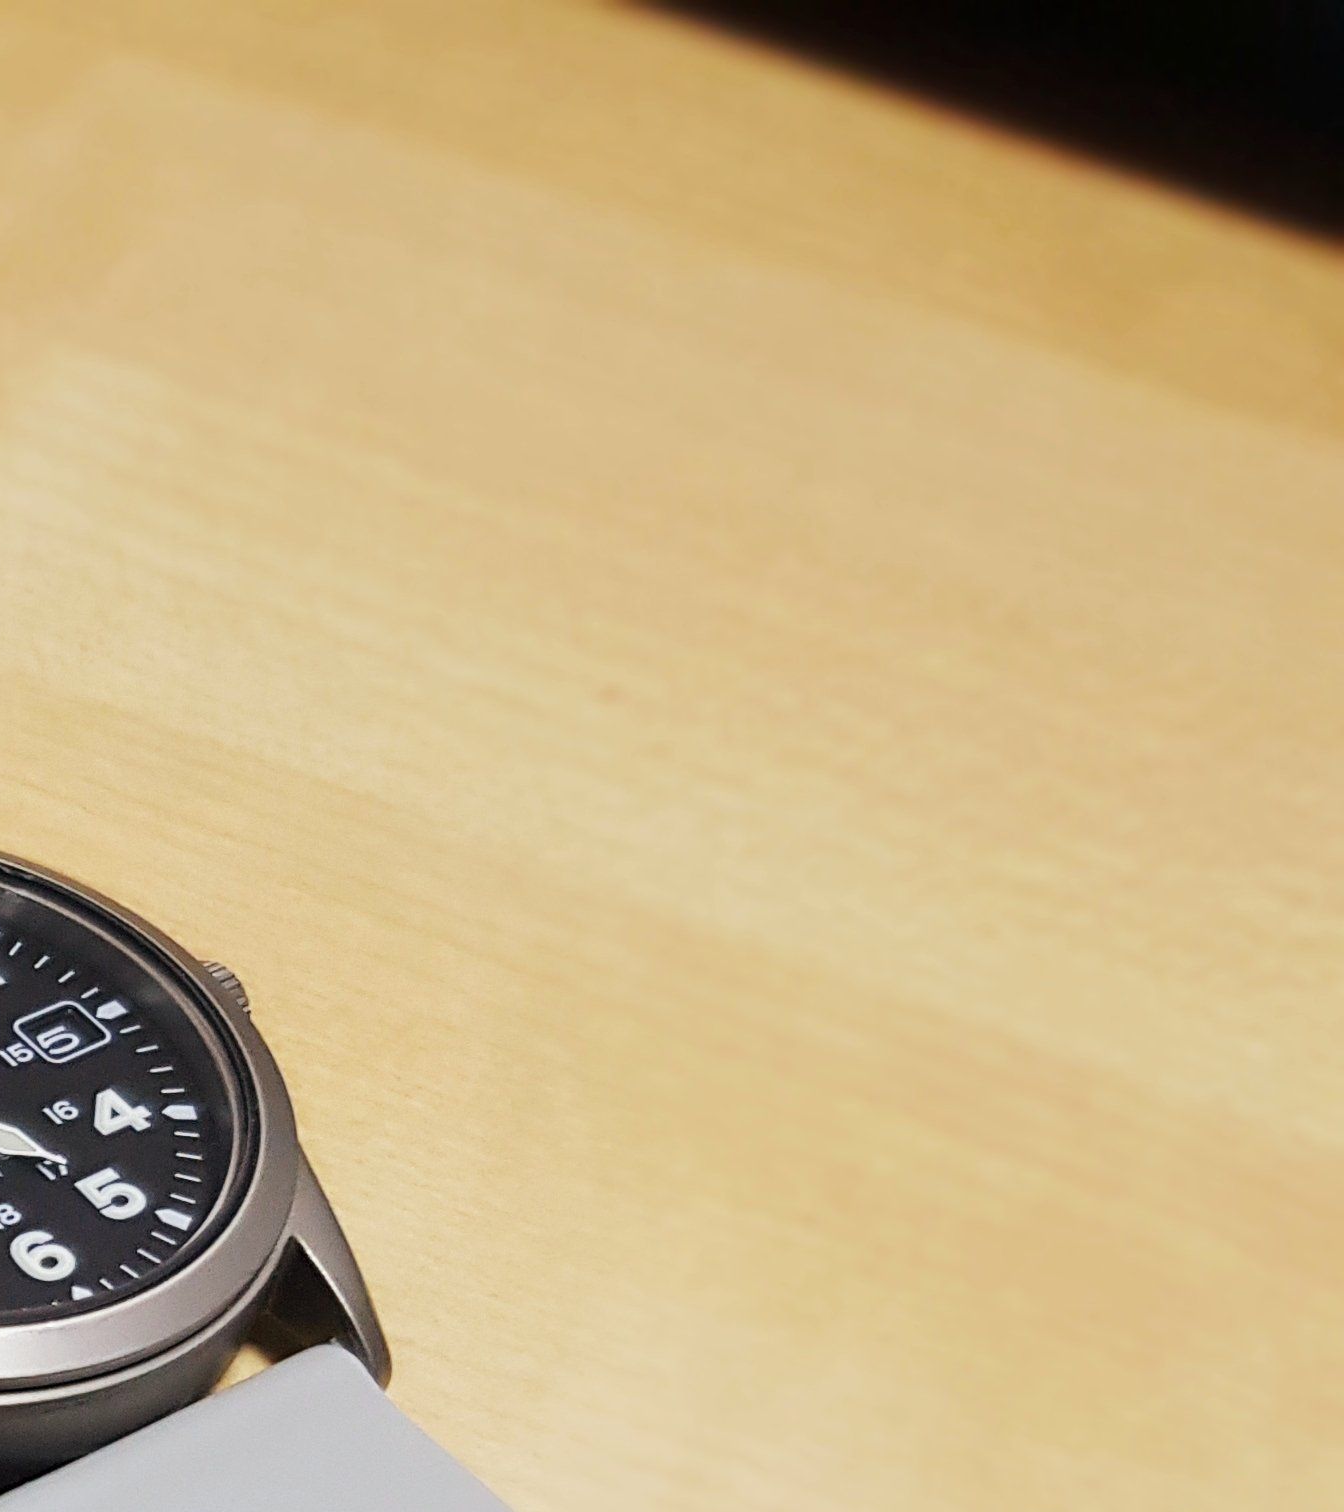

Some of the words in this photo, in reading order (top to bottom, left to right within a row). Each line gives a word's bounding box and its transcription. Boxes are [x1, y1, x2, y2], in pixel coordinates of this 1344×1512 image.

[36, 1025, 81, 1055] 5
[42, 1100, 79, 1125] 16
[94, 1087, 152, 1136] 4
[74, 1167, 147, 1220] 5
[10, 1230, 76, 1281] 6
